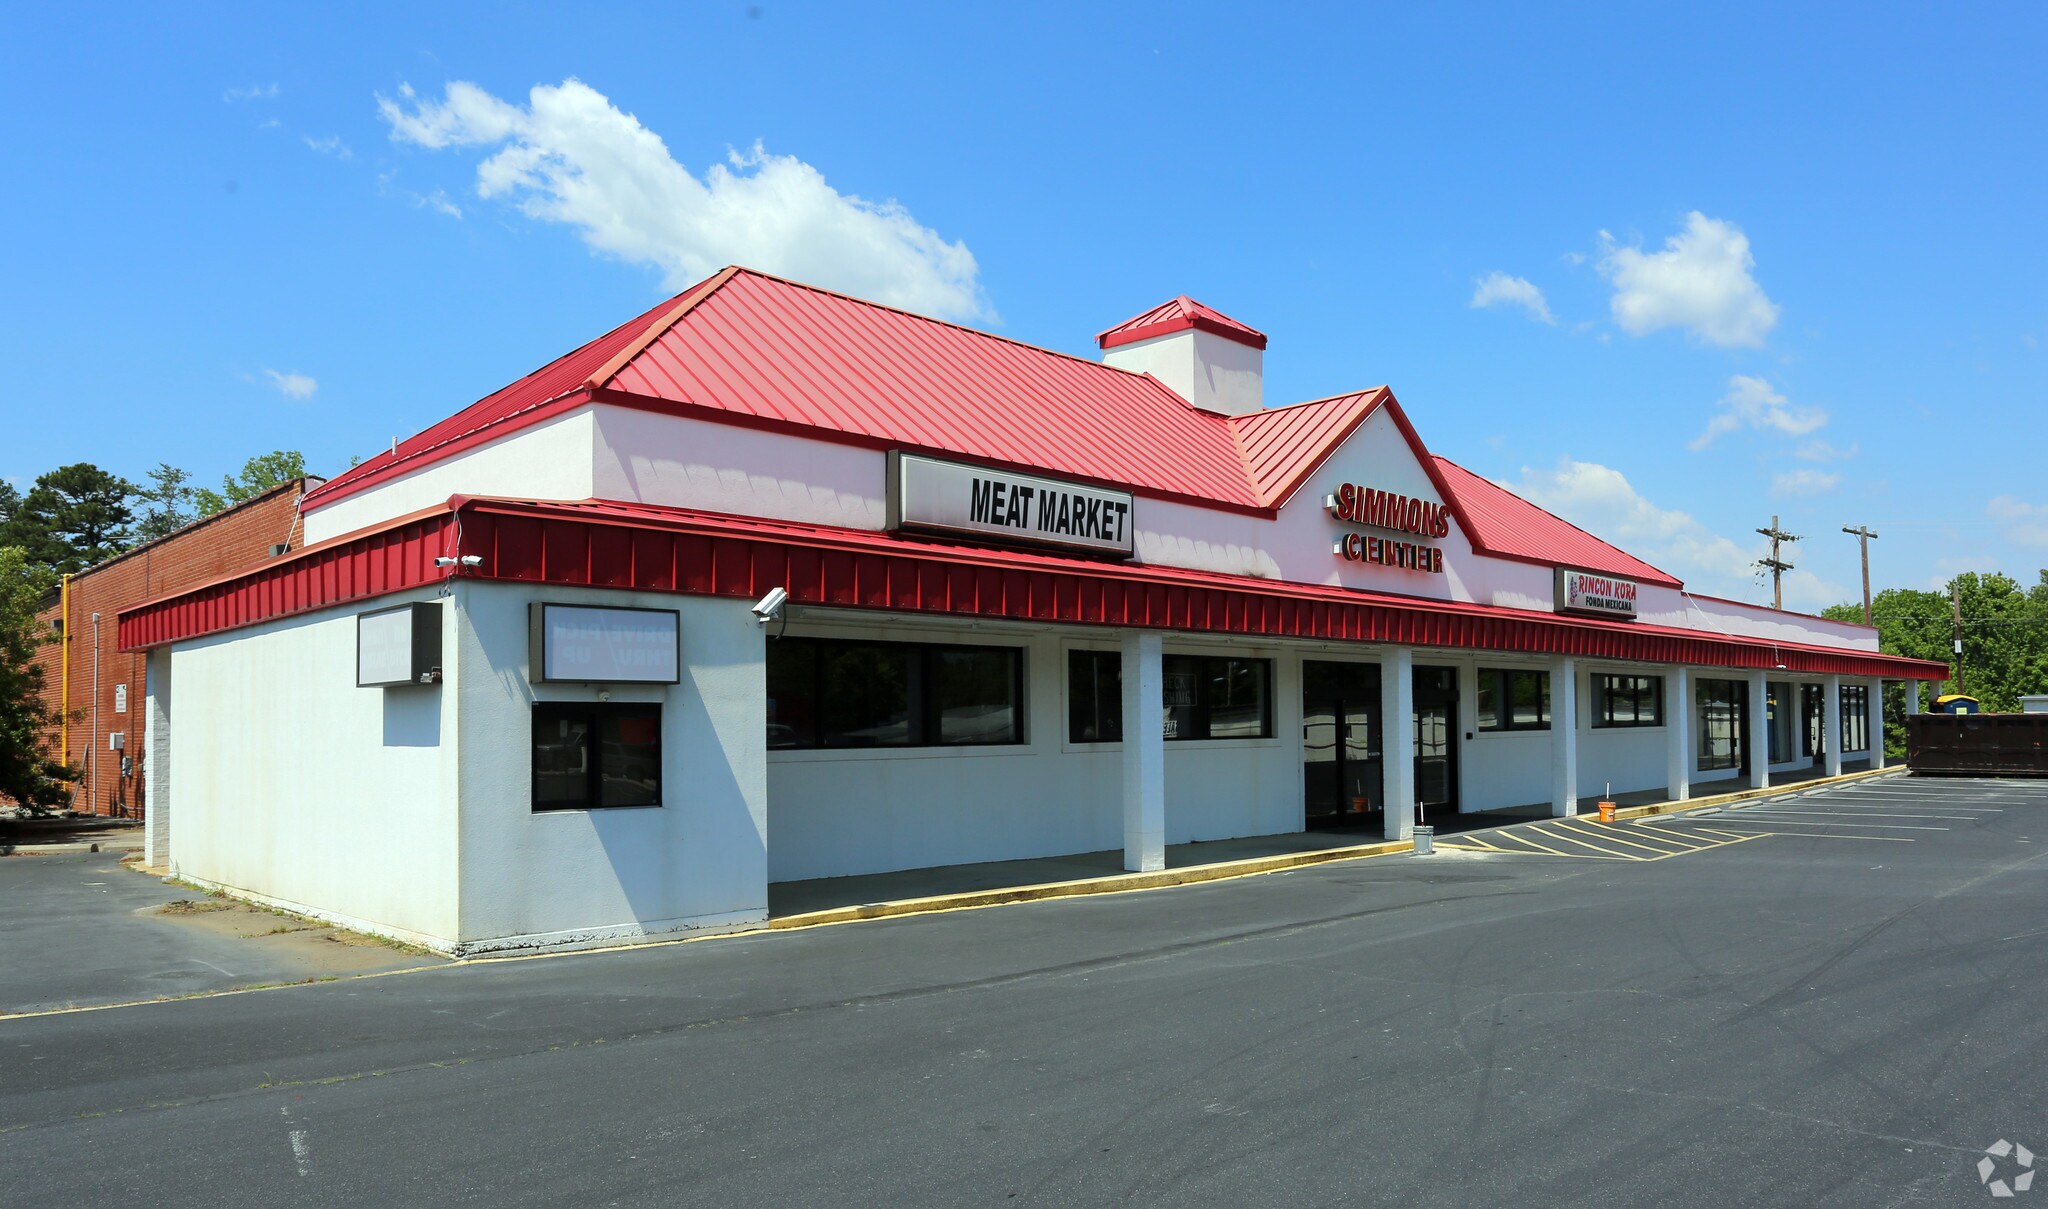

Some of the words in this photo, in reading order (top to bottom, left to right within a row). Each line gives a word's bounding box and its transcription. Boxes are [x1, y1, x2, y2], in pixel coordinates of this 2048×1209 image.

[970, 478, 1034, 528] MEAT
[1038, 489, 1128, 542] MARKET
[1334, 482, 1450, 538] SIMMONS
[1343, 532, 1442, 573] CENTER
[1579, 575, 1612, 597] RINCON
[1615, 581, 1637, 601] KORA
[1586, 596, 1604, 608] FONDA
[1605, 599, 1632, 611] MEXICANA
[1163, 676, 1186, 689] HECK
[1163, 690, 1191, 704] SHING
